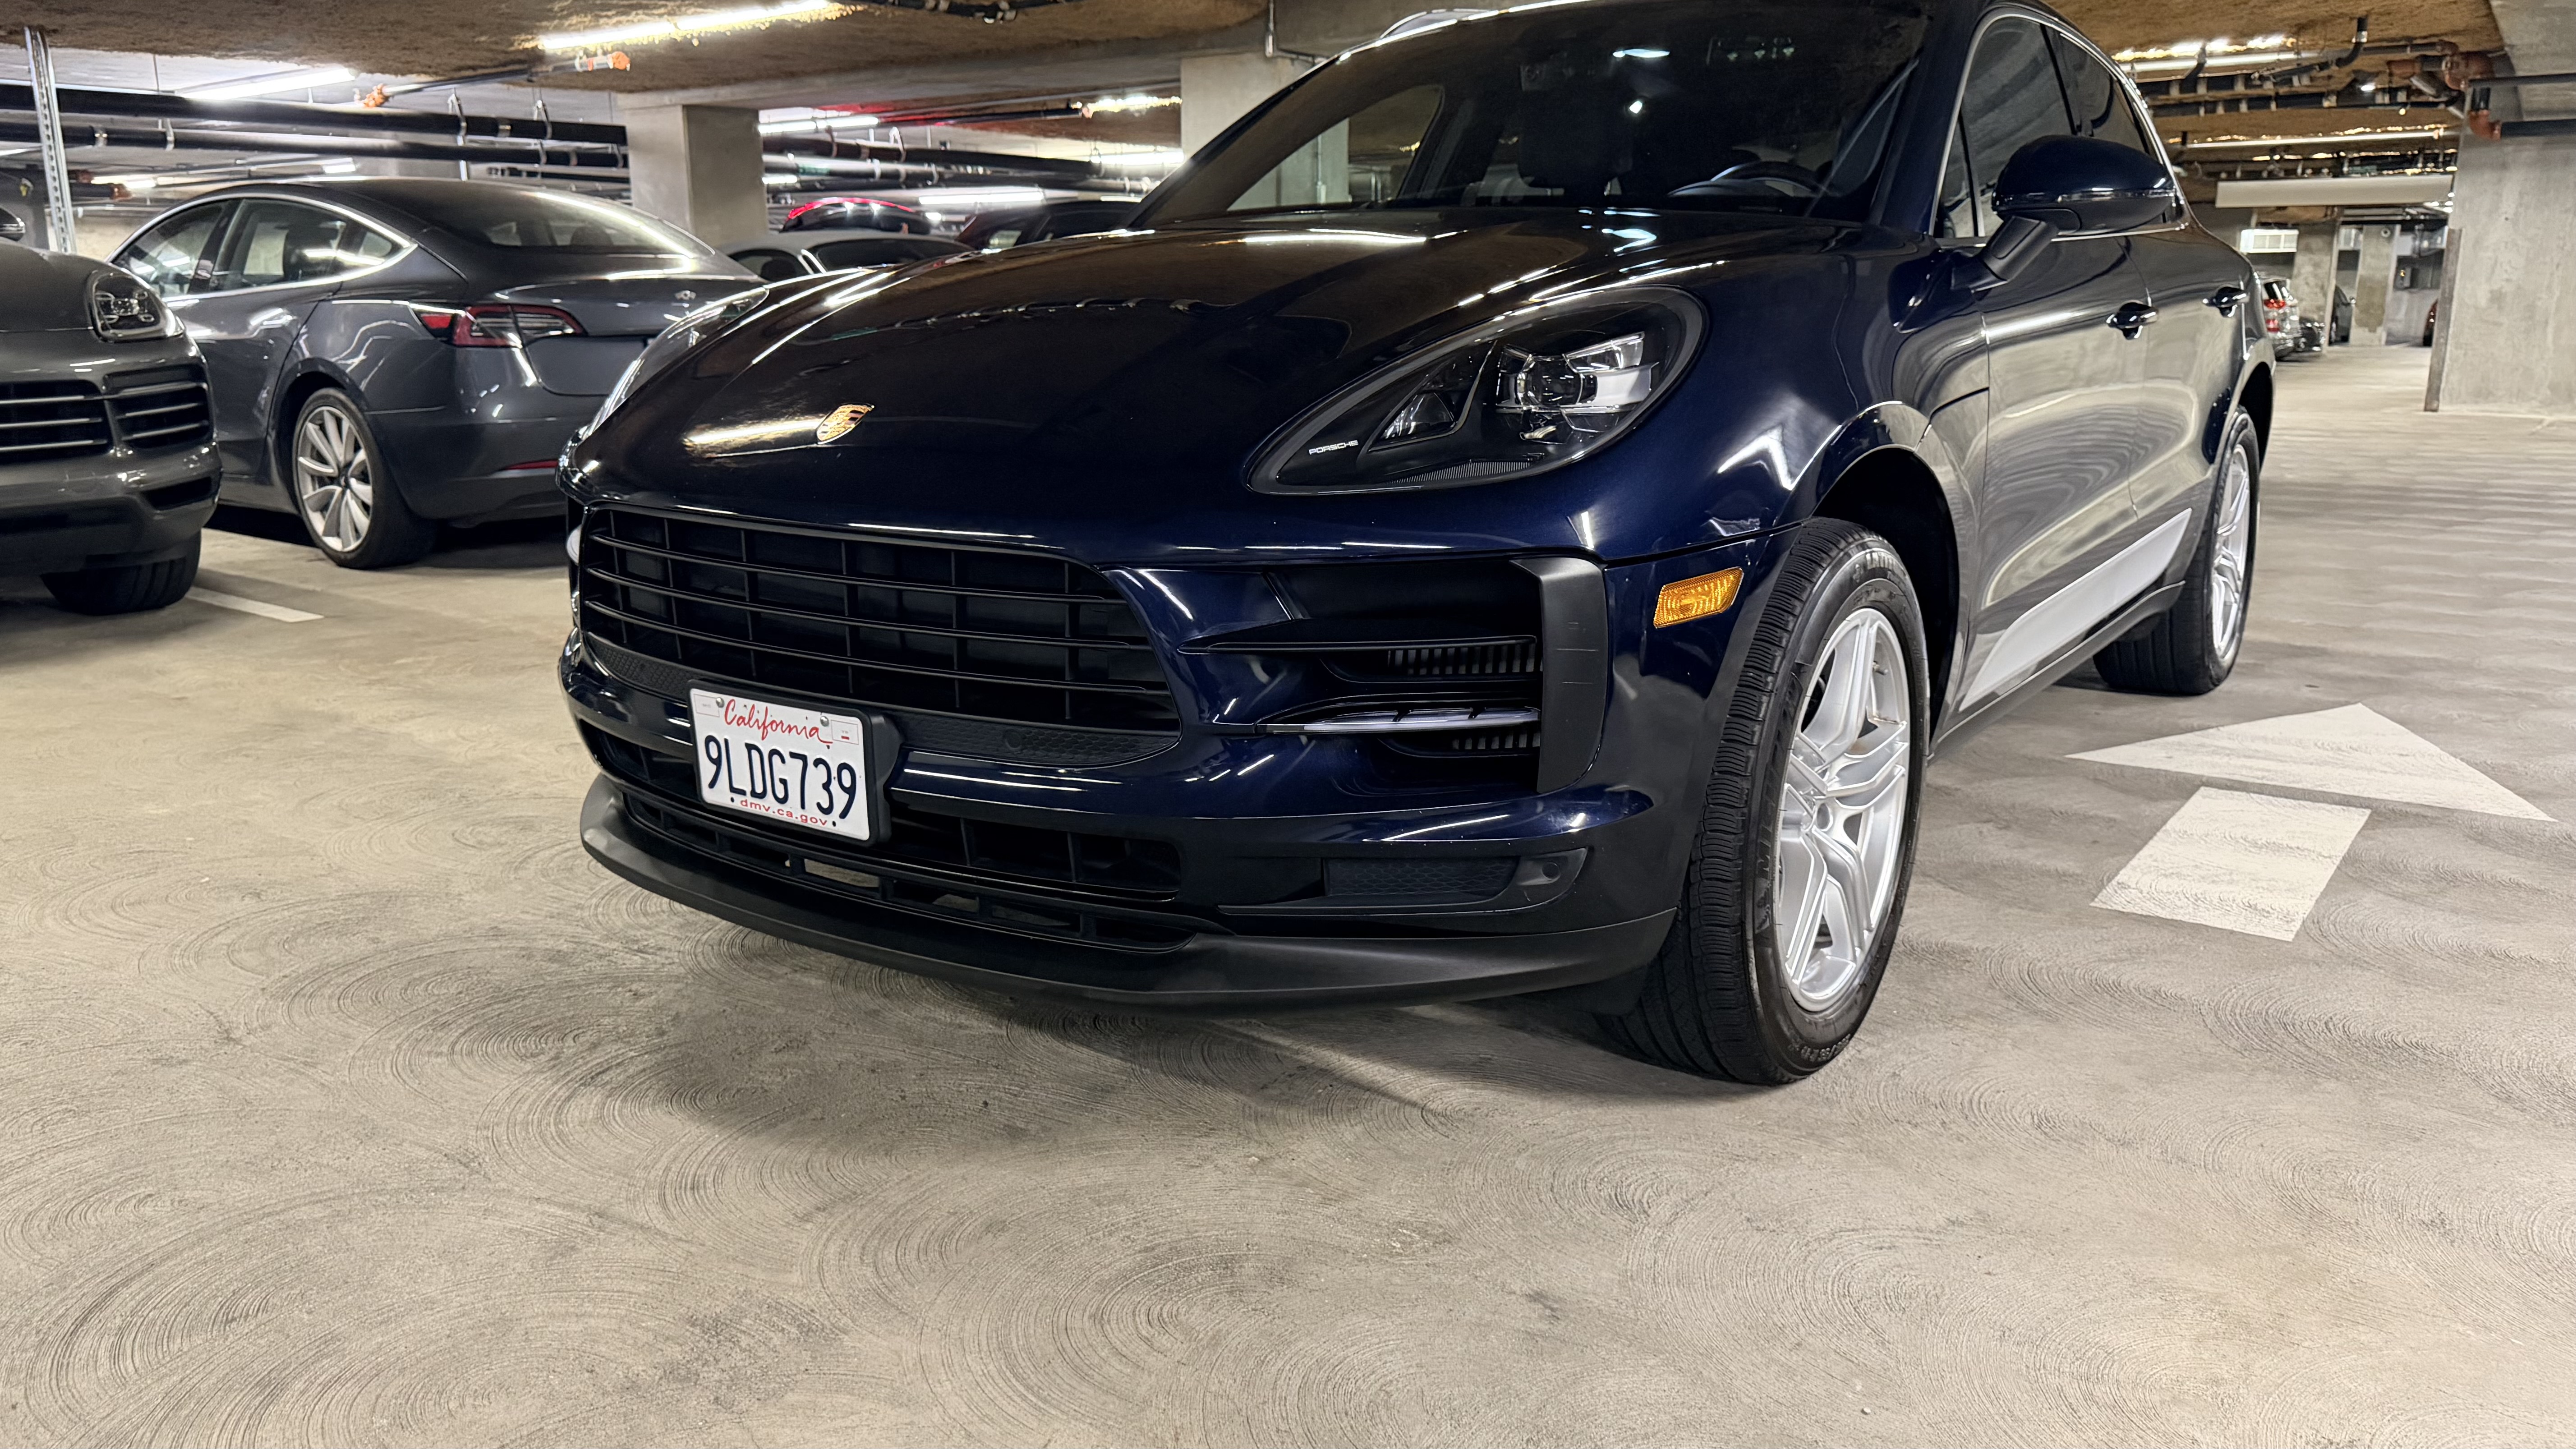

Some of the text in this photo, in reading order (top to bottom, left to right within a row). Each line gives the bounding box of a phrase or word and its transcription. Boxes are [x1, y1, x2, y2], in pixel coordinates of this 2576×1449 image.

[1309, 440, 1358, 455] PORSCHE
[724, 699, 833, 744] California
[704, 735, 856, 819] 9LDG739
[740, 799, 827, 826] dmv.ca.gov
